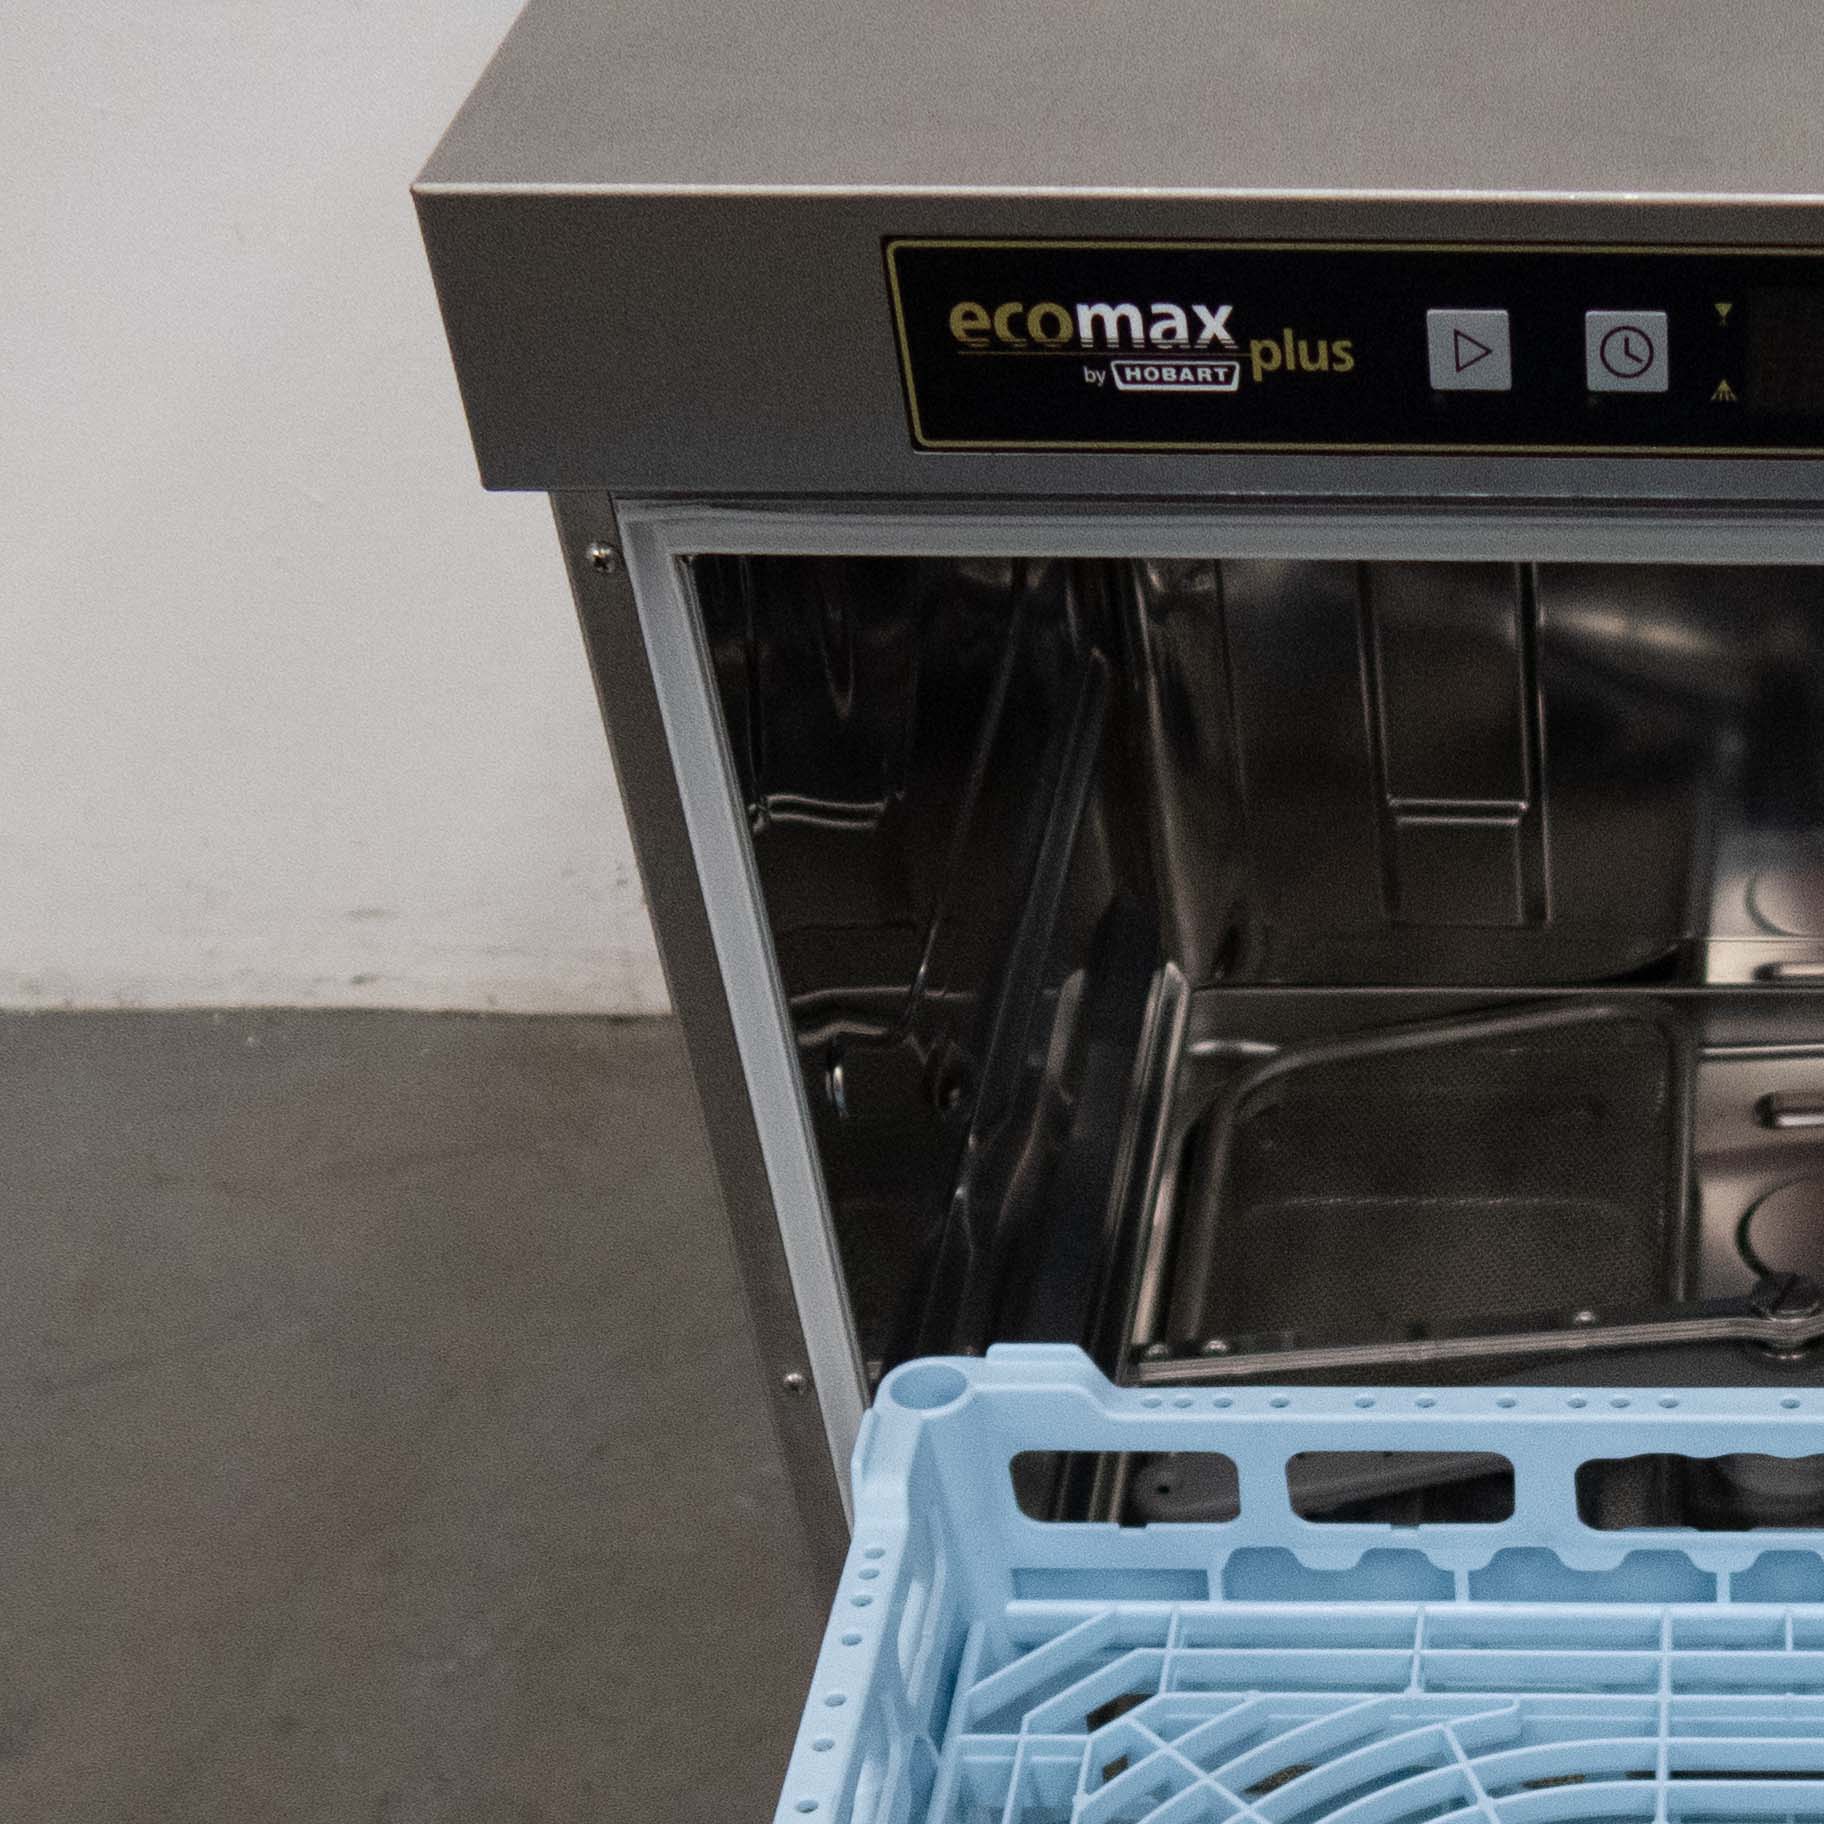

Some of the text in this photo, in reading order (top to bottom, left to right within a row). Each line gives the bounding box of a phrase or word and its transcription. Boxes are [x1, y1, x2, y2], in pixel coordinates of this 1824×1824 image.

[949, 301, 1355, 382] ecomax plus
[1083, 366, 1229, 387] by HOBART
